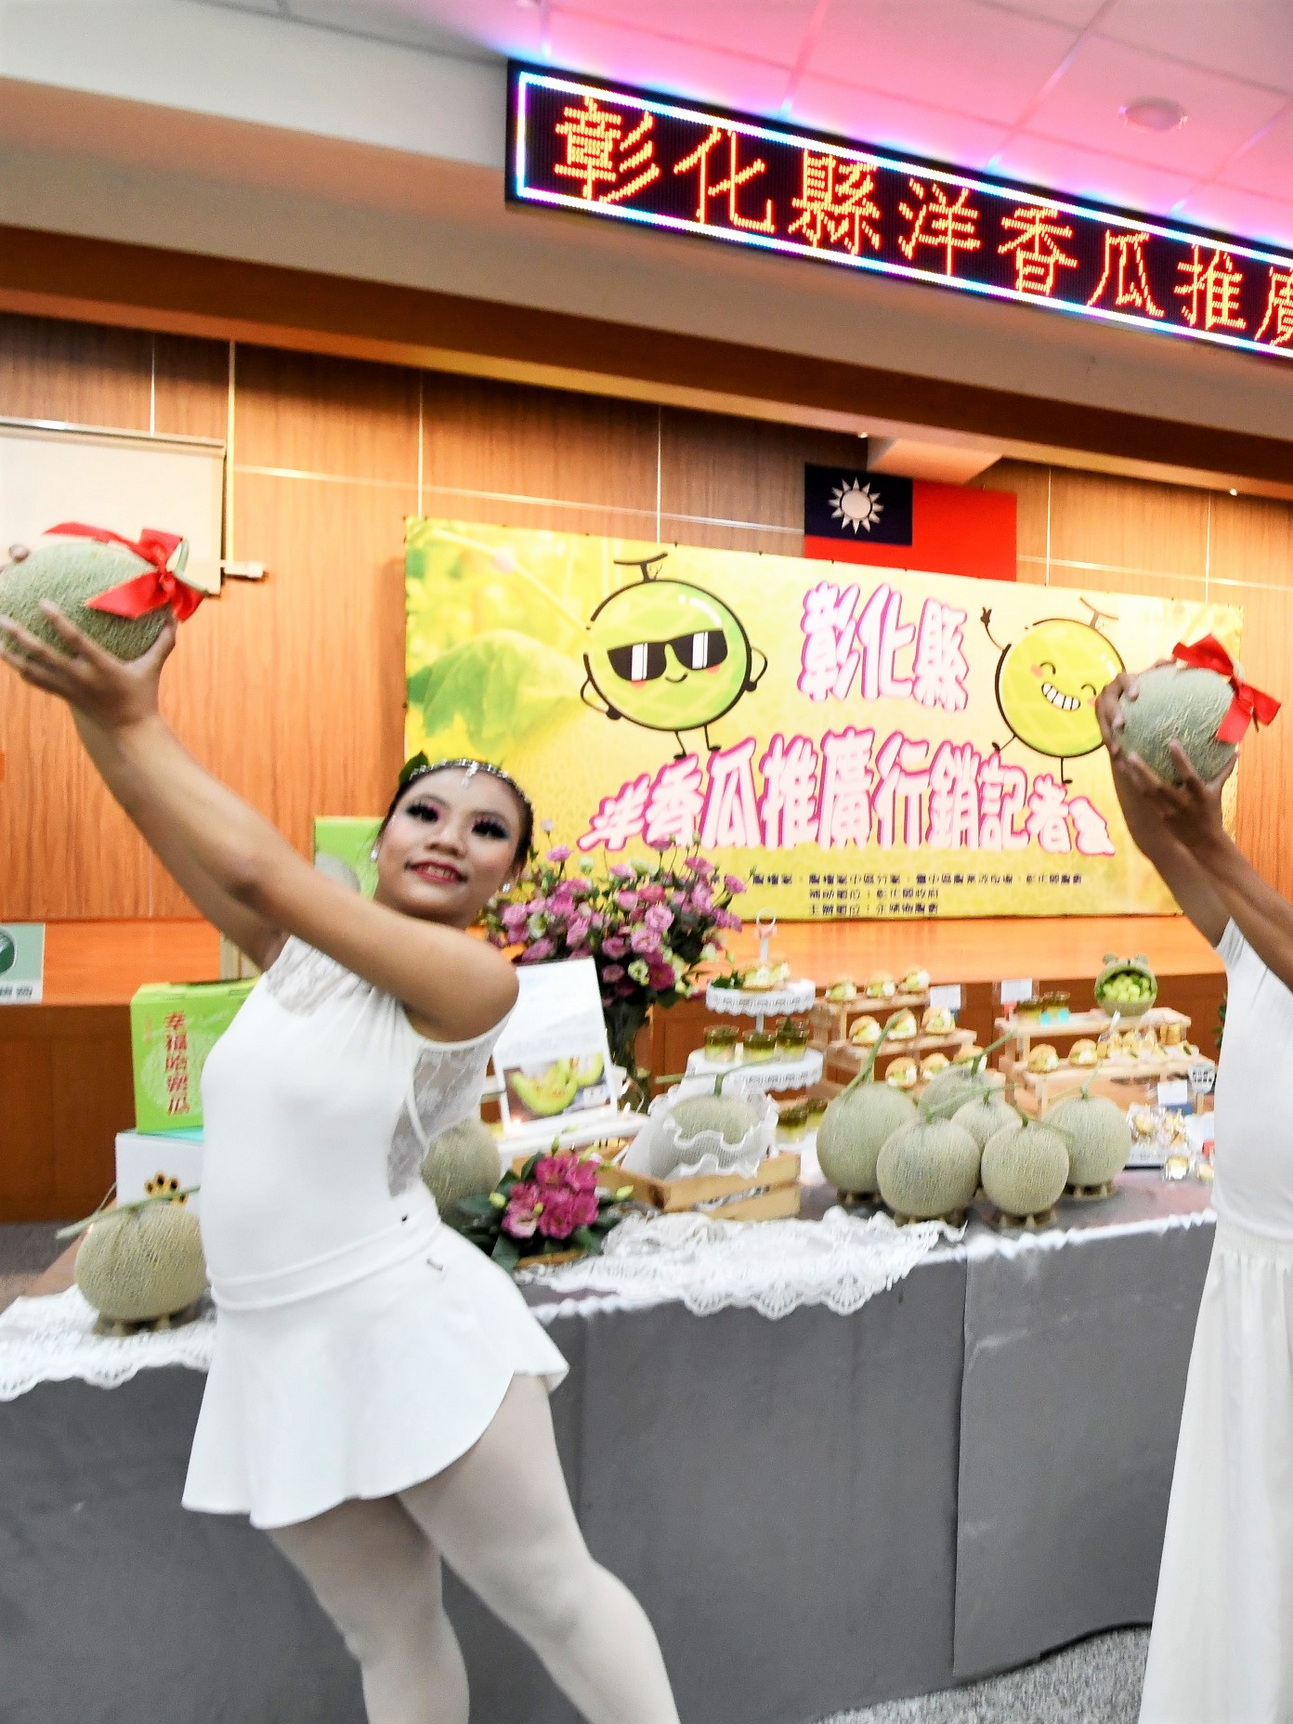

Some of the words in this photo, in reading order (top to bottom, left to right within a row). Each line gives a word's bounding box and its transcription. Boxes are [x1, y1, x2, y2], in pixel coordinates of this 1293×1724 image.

[797, 581, 969, 711] 彰化縣
[578, 726, 1117, 857] 洋香瓜推廣行銷記者會
